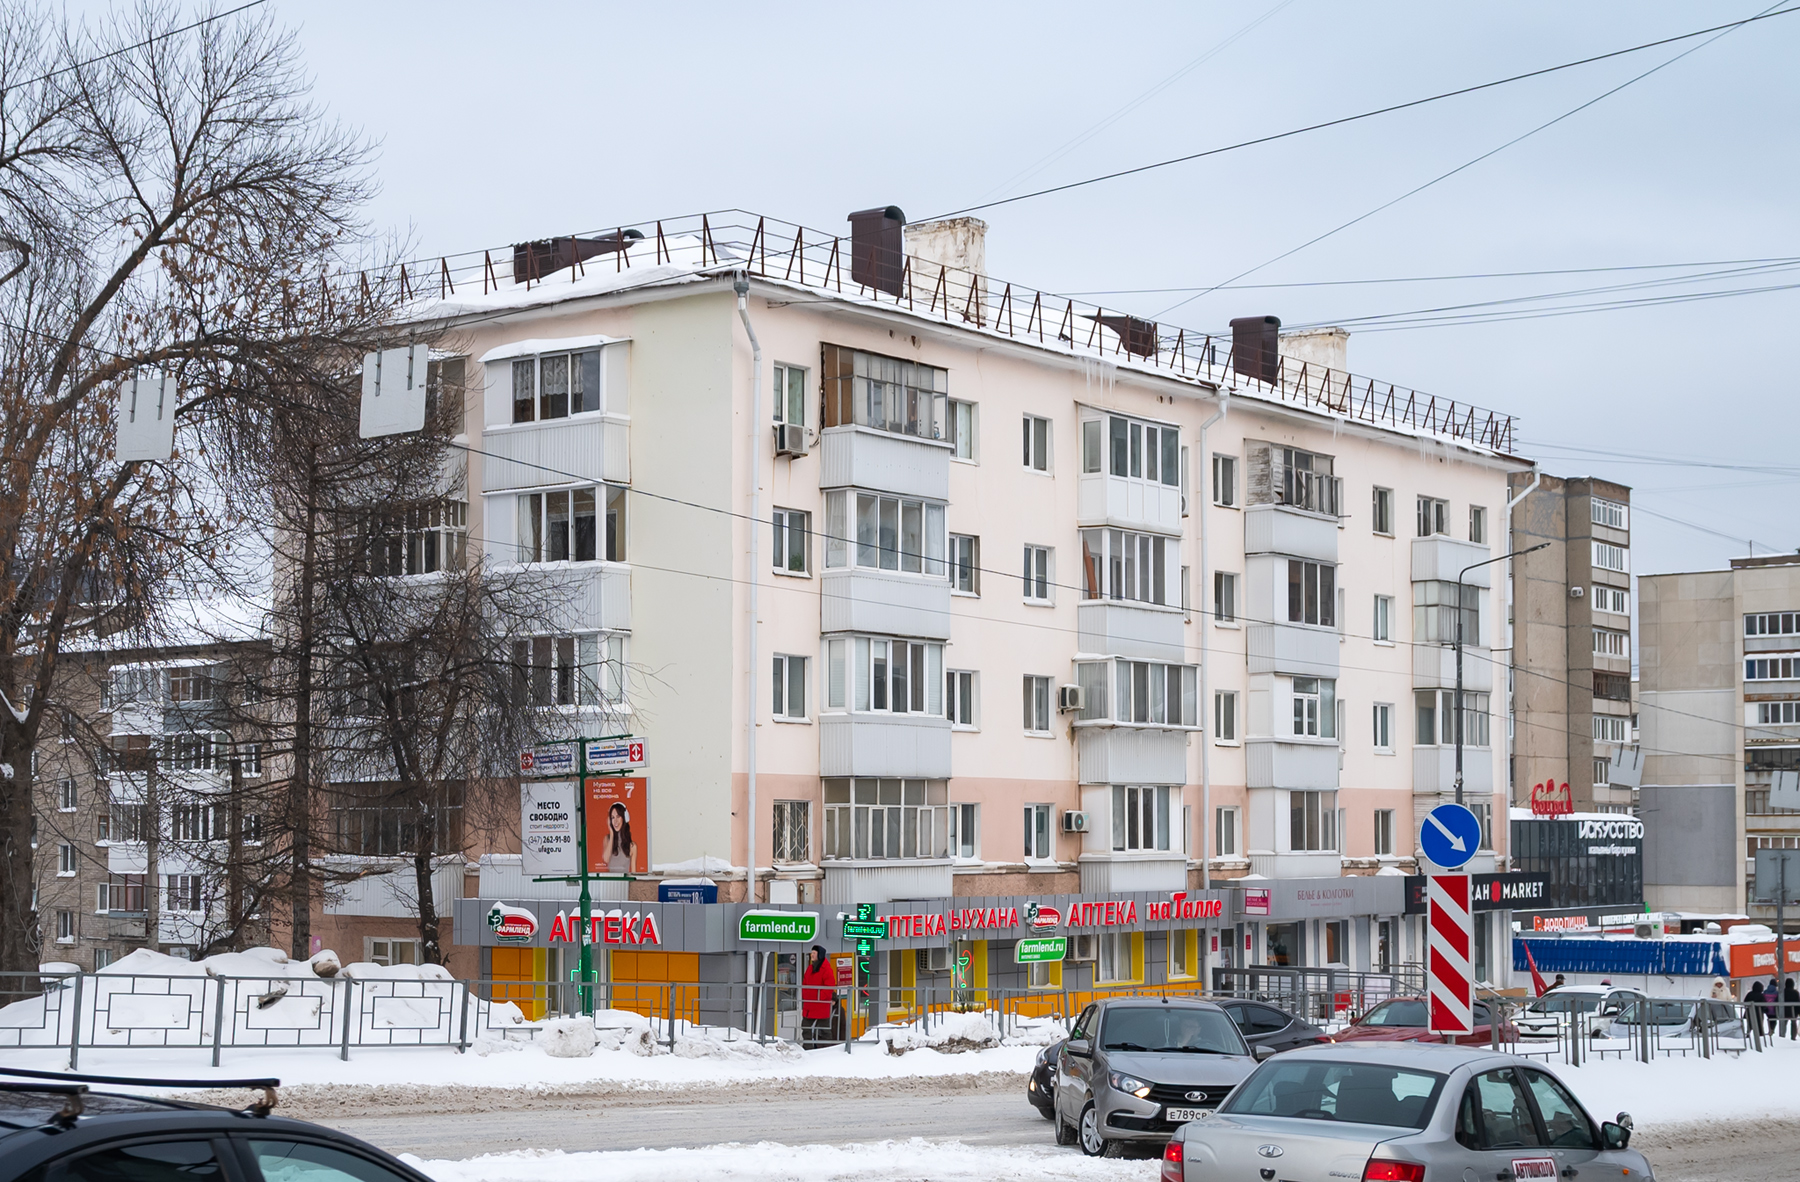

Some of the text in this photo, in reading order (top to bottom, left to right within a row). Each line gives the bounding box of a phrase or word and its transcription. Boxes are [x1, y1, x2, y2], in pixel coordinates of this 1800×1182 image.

[625, 786, 635, 799] 7
[537, 801, 560, 810] МЕСТО
[529, 812, 569, 822] СВОБОДНО
[528, 835, 571, 846] (347) 262-91-80
[538, 845, 562, 855] ufago.ru
[1297, 889, 1354, 901] БЕЛЬЕ & КОЛГОТКИ
[1471, 883, 1490, 901] АН
[1502, 881, 1544, 899] MARKET
[1068, 901, 1138, 927] АПТЕКА
[1149, 902, 1171, 920] на
[947, 907, 1019, 930] ЫУХАНА
[496, 924, 531, 935] ФАРМЛЕНД
[745, 920, 811, 934] farmlend.ru
[879, 914, 947, 938] ПТЕКА
[1021, 941, 1064, 953] farmlend.ru
[1515, 1161, 1556, 1179] АВТОШКОЛА
